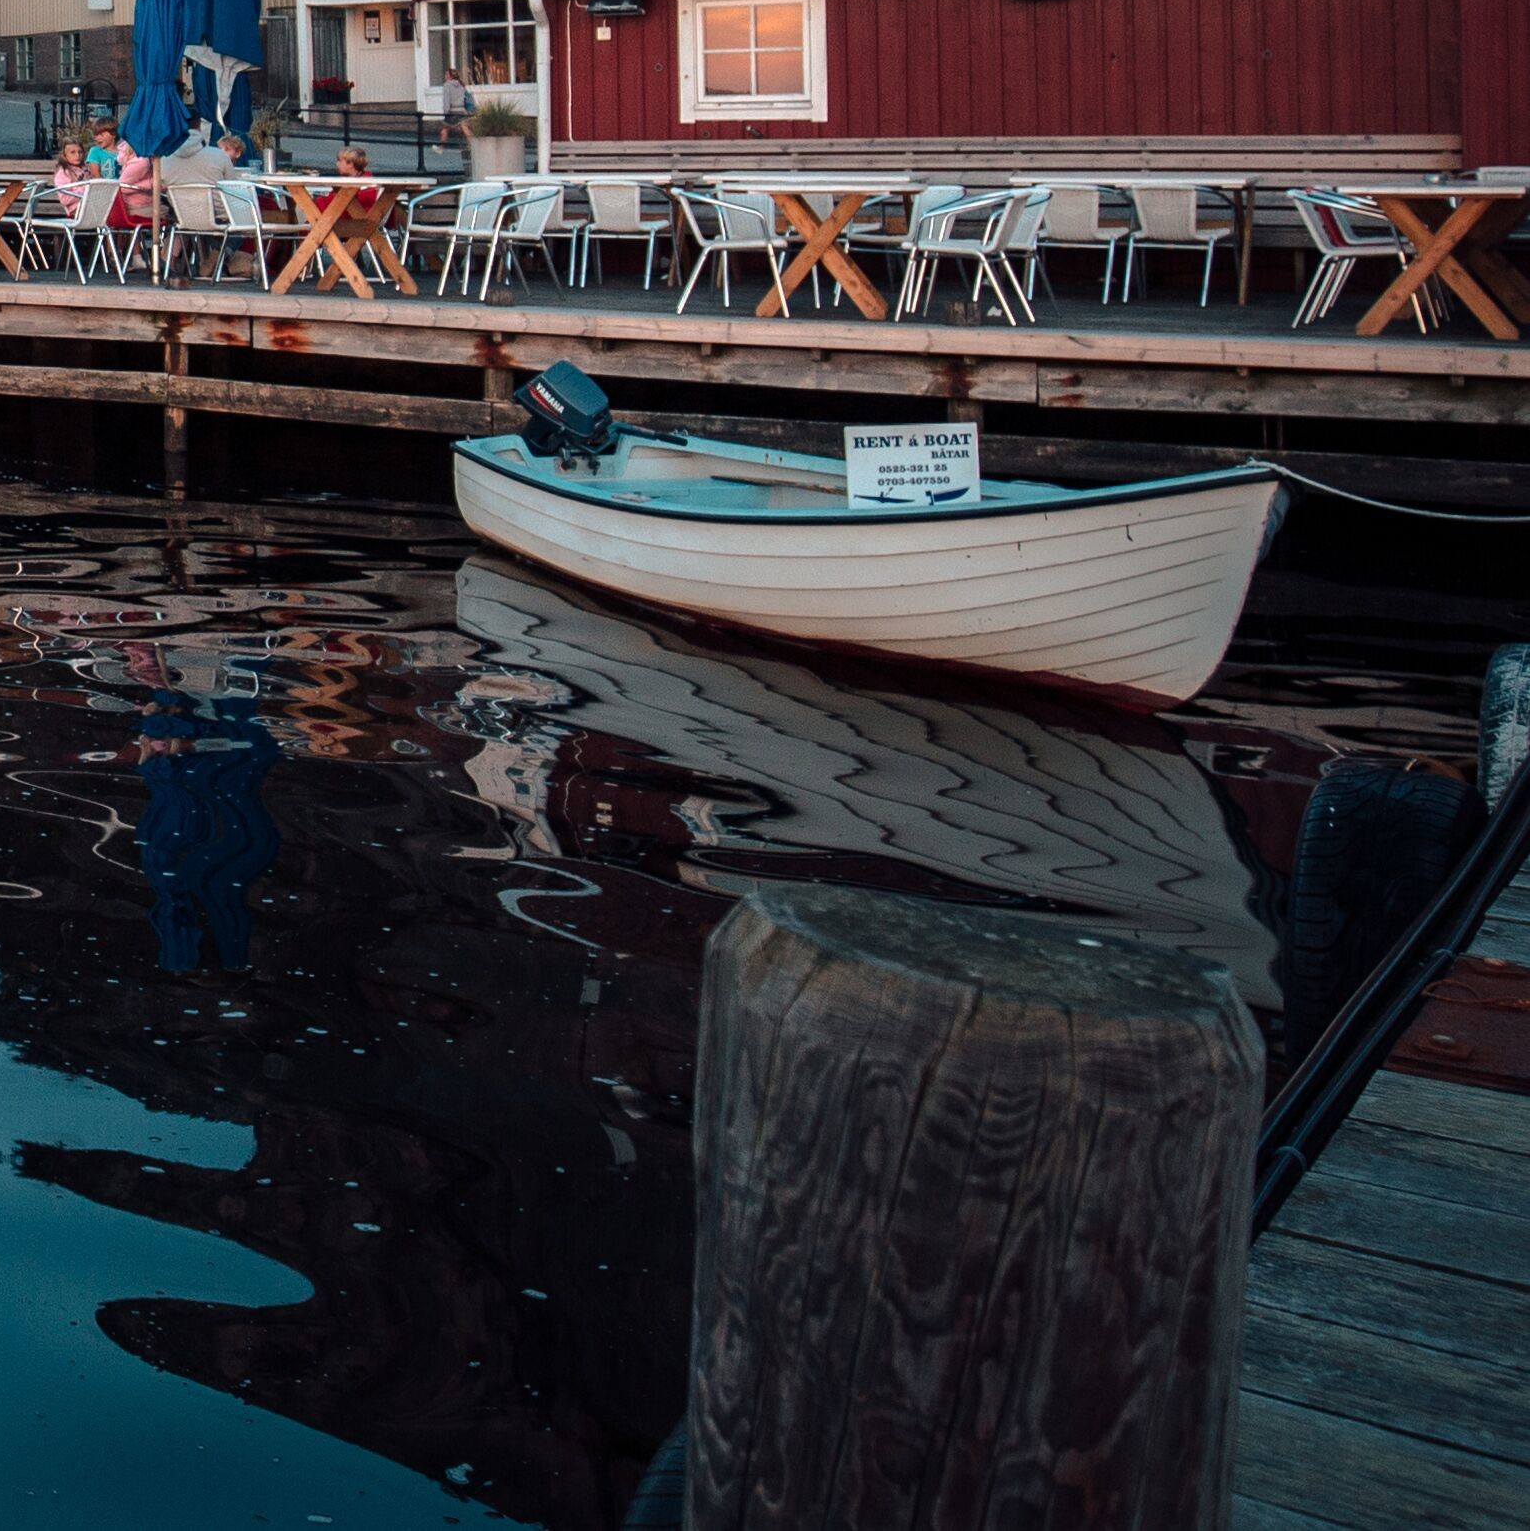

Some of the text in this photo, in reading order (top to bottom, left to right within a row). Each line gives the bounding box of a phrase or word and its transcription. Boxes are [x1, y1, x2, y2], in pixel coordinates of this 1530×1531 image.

[535, 382, 566, 414] YAMAHA
[852, 435, 904, 449] RENT
[923, 433, 972, 447] BOAT
[931, 447, 970, 459] BÅTAR
[933, 463, 948, 472] 25
